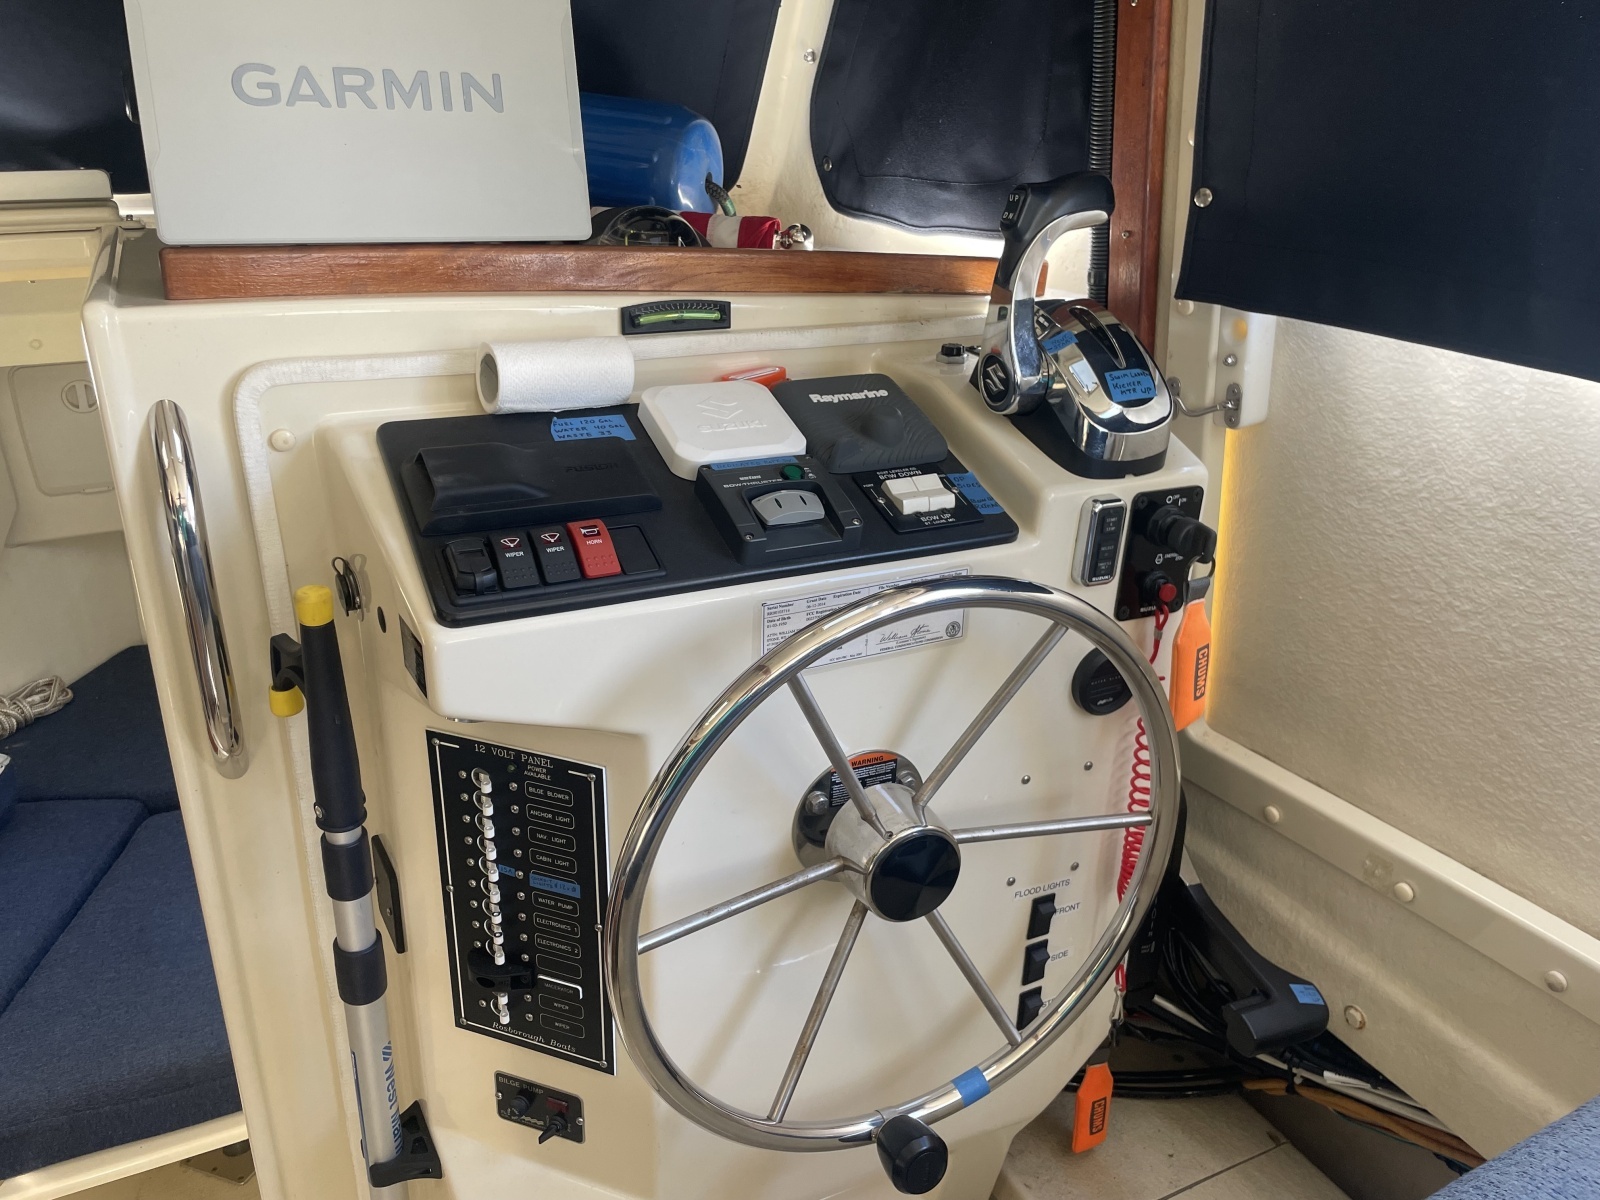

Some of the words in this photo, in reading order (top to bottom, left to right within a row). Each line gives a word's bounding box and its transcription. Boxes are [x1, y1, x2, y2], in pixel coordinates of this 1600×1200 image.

[231, 62, 504, 113] GARMIN
[1009, 194, 1020, 202] UP
[1002, 211, 1015, 219] DN
[1112, 380, 1142, 390] KICKER
[1120, 387, 1137, 395] MTR
[1140, 387, 1152, 395] UP
[808, 389, 889, 403] Raymarine
[898, 470, 922, 478] DOWN
[1196, 647, 1208, 697] CHUMS
[474, 743, 486, 753] 12
[491, 747, 515, 760] VOLT
[520, 753, 554, 769] PANEL
[851, 755, 884, 767] WARNING
[524, 770, 551, 781] AVAILABLE
[527, 765, 547, 774] POWER
[528, 786, 544, 795] BILGE
[547, 791, 569, 800] BLOWER
[530, 810, 553, 819] ANCHOR
[555, 815, 570, 823] LIGHT
[551, 837, 566, 845] LIGHT
[535, 854, 552, 863] CABIN
[554, 859, 570, 867] LIGHT
[1014, 886, 1041, 899] FLOOD
[1042, 879, 1071, 892] LIGHTS
[538, 897, 555, 906] WATER
[557, 902, 573, 910] PUMP
[1055, 902, 1081, 915] FRONT
[536, 917, 571, 931] ELECTRONICS
[537, 938, 572, 952] ELECTRONICS
[1050, 950, 1069, 962] SIDE
[553, 1002, 569, 1010] WIPER
[554, 1022, 570, 1030] WIPER
[492, 1021, 545, 1043] Rosborough
[550, 1039, 576, 1052] Boats
[385, 1059, 397, 1110] West
[498, 1076, 520, 1088] BILGE
[522, 1084, 544, 1094] PUMP
